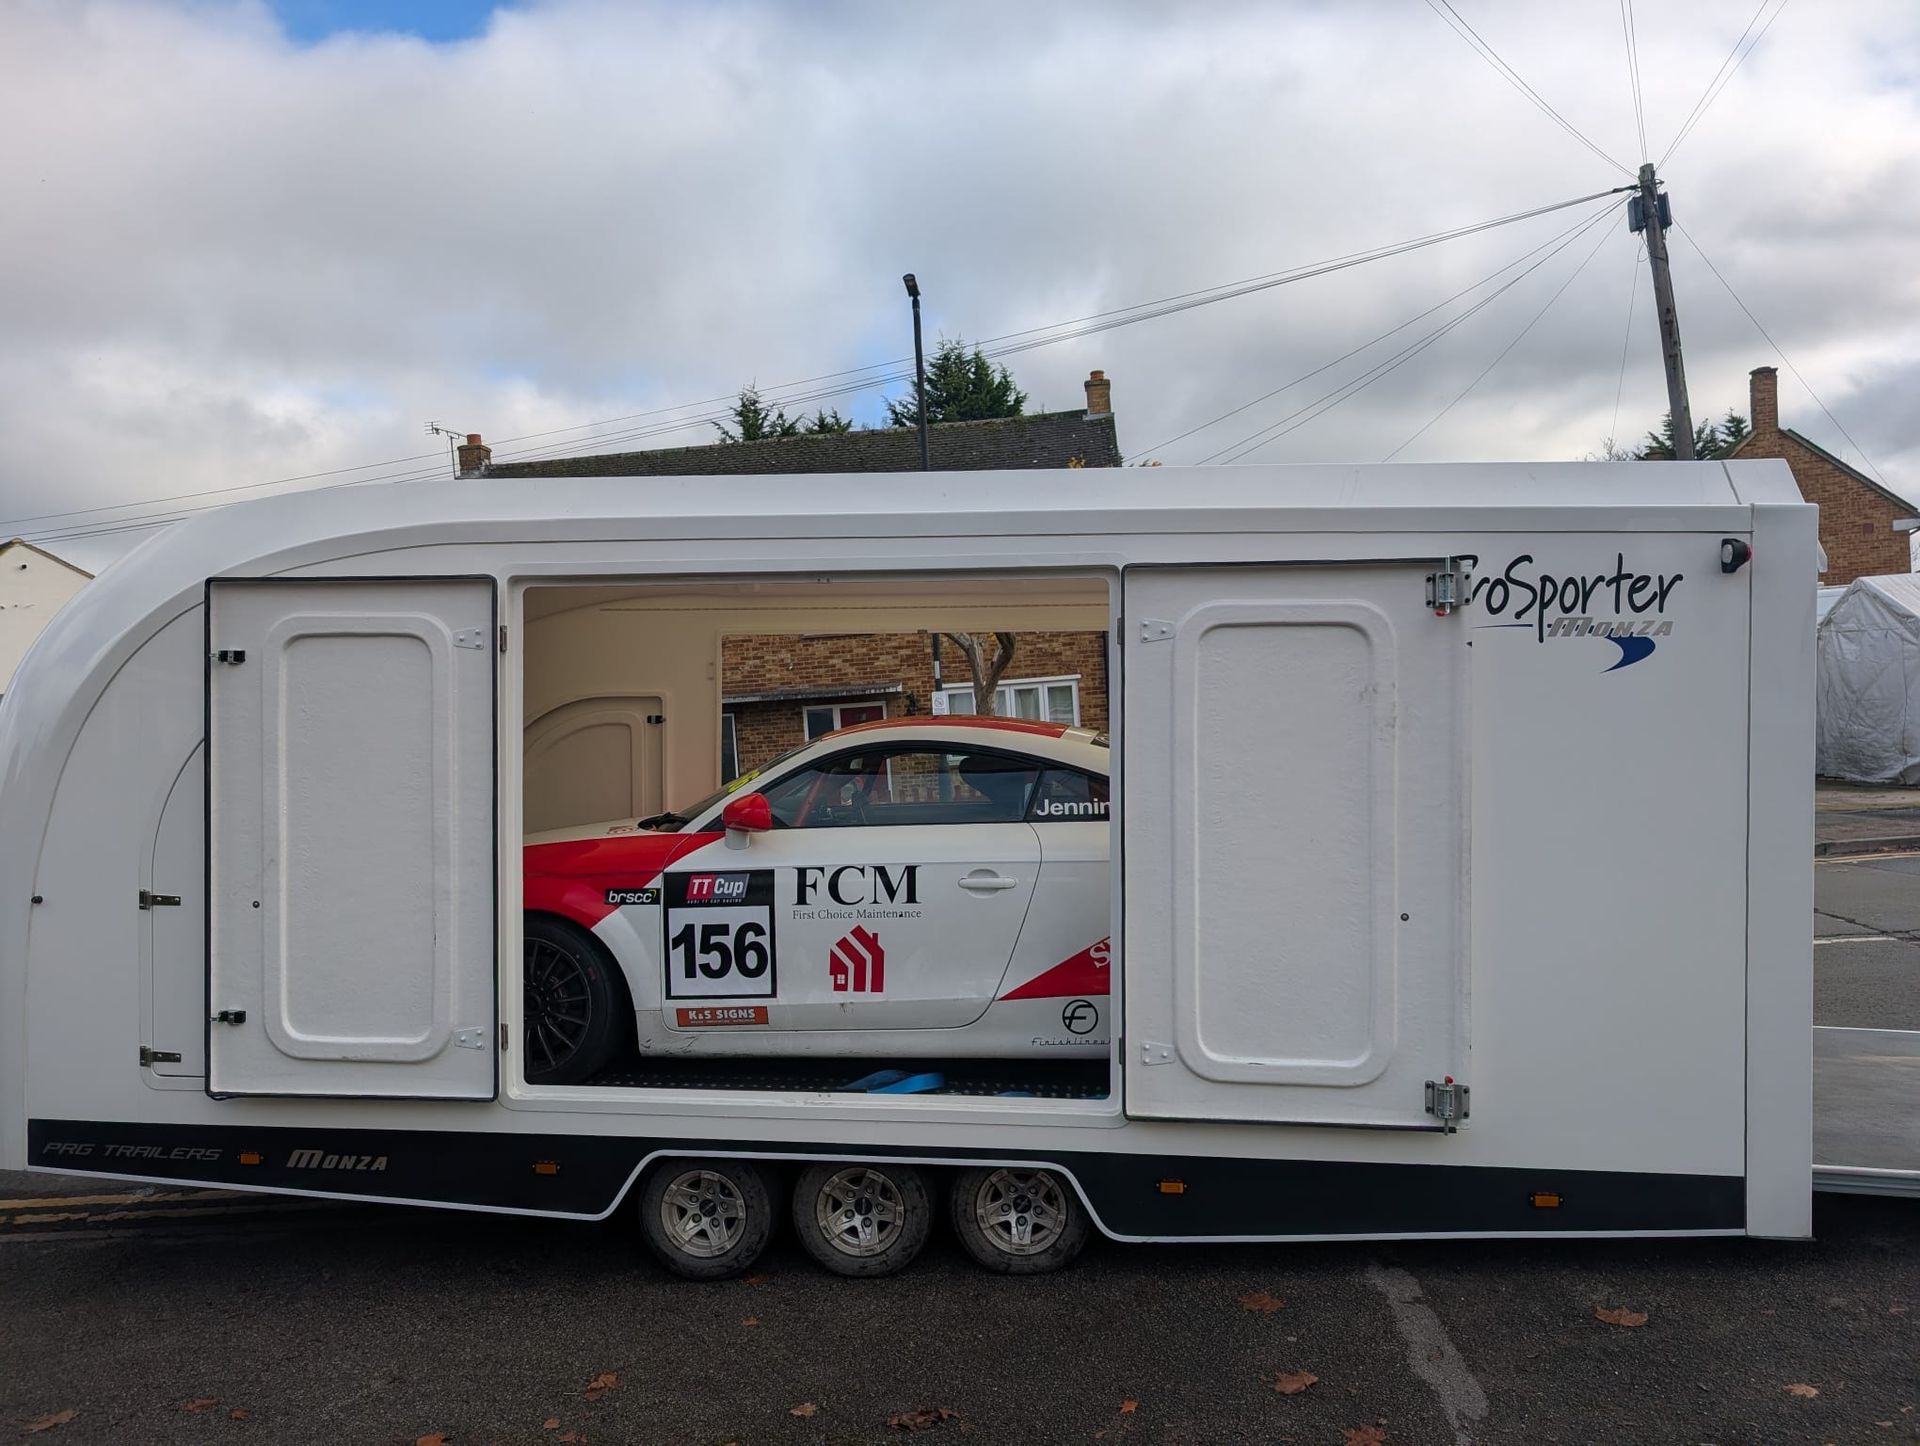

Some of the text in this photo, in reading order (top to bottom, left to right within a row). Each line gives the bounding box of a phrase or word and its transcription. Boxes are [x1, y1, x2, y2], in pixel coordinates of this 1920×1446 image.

[692, 878, 744, 897] TT Cup
[792, 865, 922, 906] FCM
[608, 890, 653, 903] brscc
[792, 909, 922, 920] First Choice Maintenance
[671, 922, 769, 979] 156
[1089, 941, 1110, 969] S
[688, 1008, 756, 1020] K&S SIGNS
[43, 1142, 222, 1161] PRG TRAILERS
